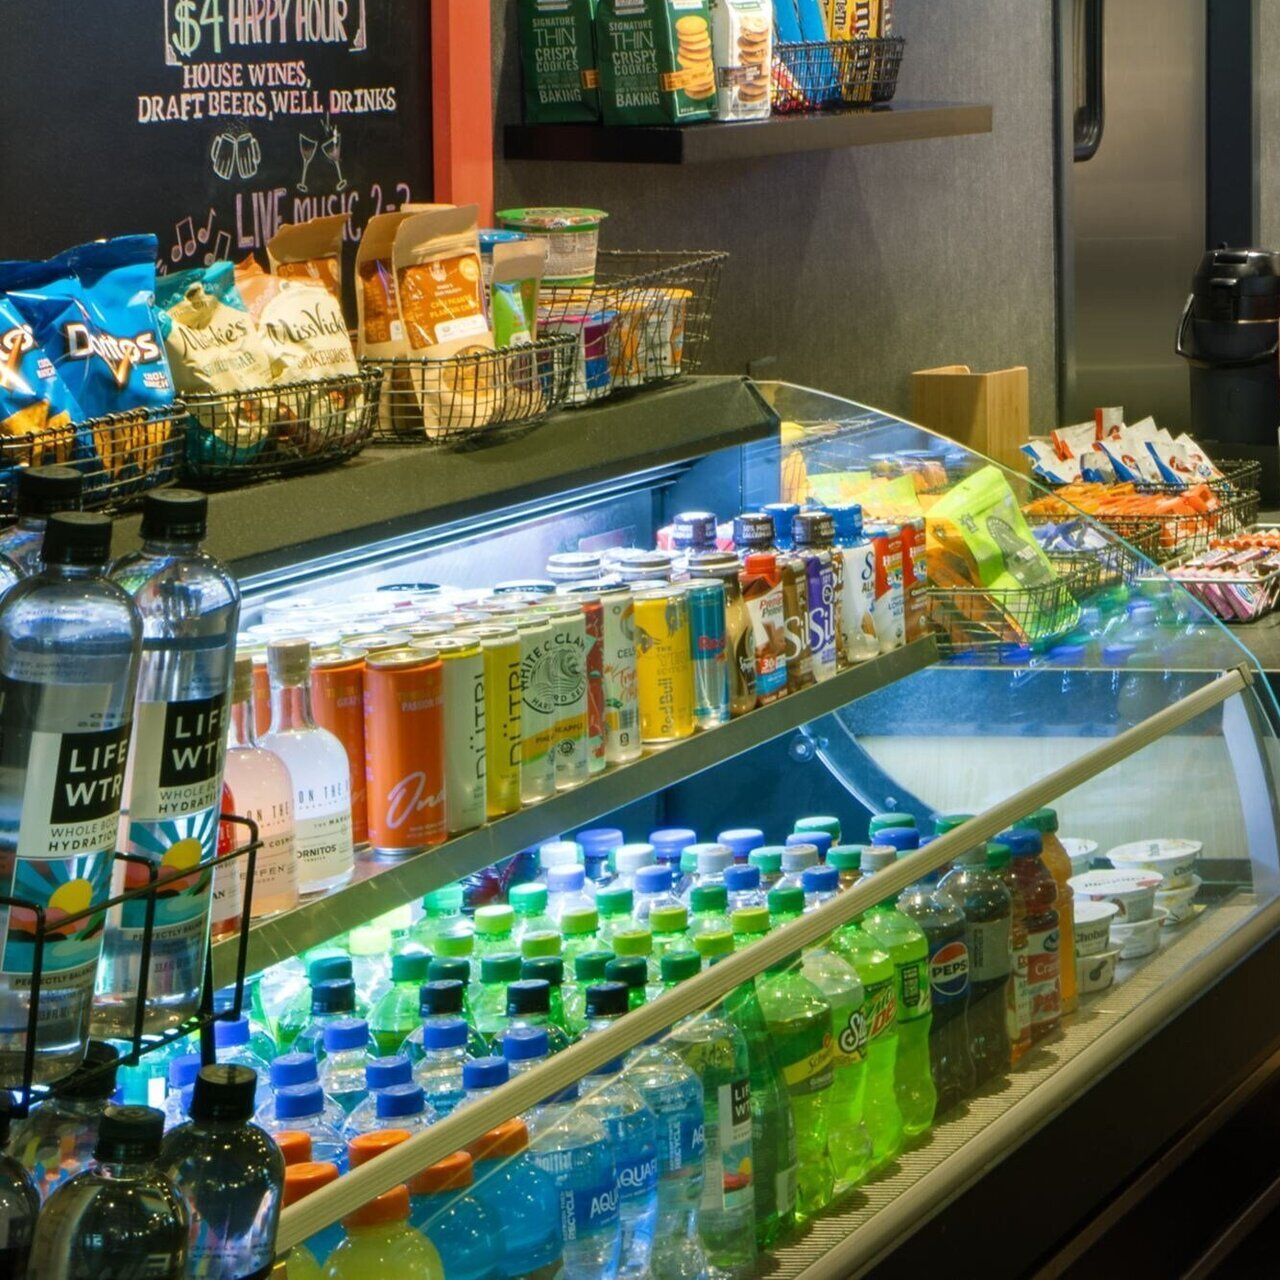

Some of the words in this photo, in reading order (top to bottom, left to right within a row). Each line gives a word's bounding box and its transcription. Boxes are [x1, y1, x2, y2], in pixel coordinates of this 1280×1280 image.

[532, 16, 576, 27] SIGNATURE
[608, 20, 654, 31] SIGNATURE
[533, 27, 576, 47] THIN
[610, 31, 654, 50] THIN
[535, 46, 578, 63] CRISPY
[612, 50, 657, 66] CRISPY
[183, 63, 243, 88] HOUSE
[249, 60, 312, 90] WINES,
[536, 59, 580, 73] COOKIES
[614, 62, 658, 75] COOKIES
[138, 94, 204, 124] DRAFT
[271, 91, 323, 115] WELL
[329, 87, 397, 116] DRINKS
[539, 89, 582, 104] BAKING
[616, 91, 660, 108] BAKING
[65, 322, 162, 365] Doritos
[784, 612, 811, 660] Sil
[809, 606, 836, 652] Sil
[70, 740, 127, 773] LIFE
[65, 774, 122, 808] WTR
[51, 823, 98, 838] WHOLE
[932, 960, 968, 978] PEPS
